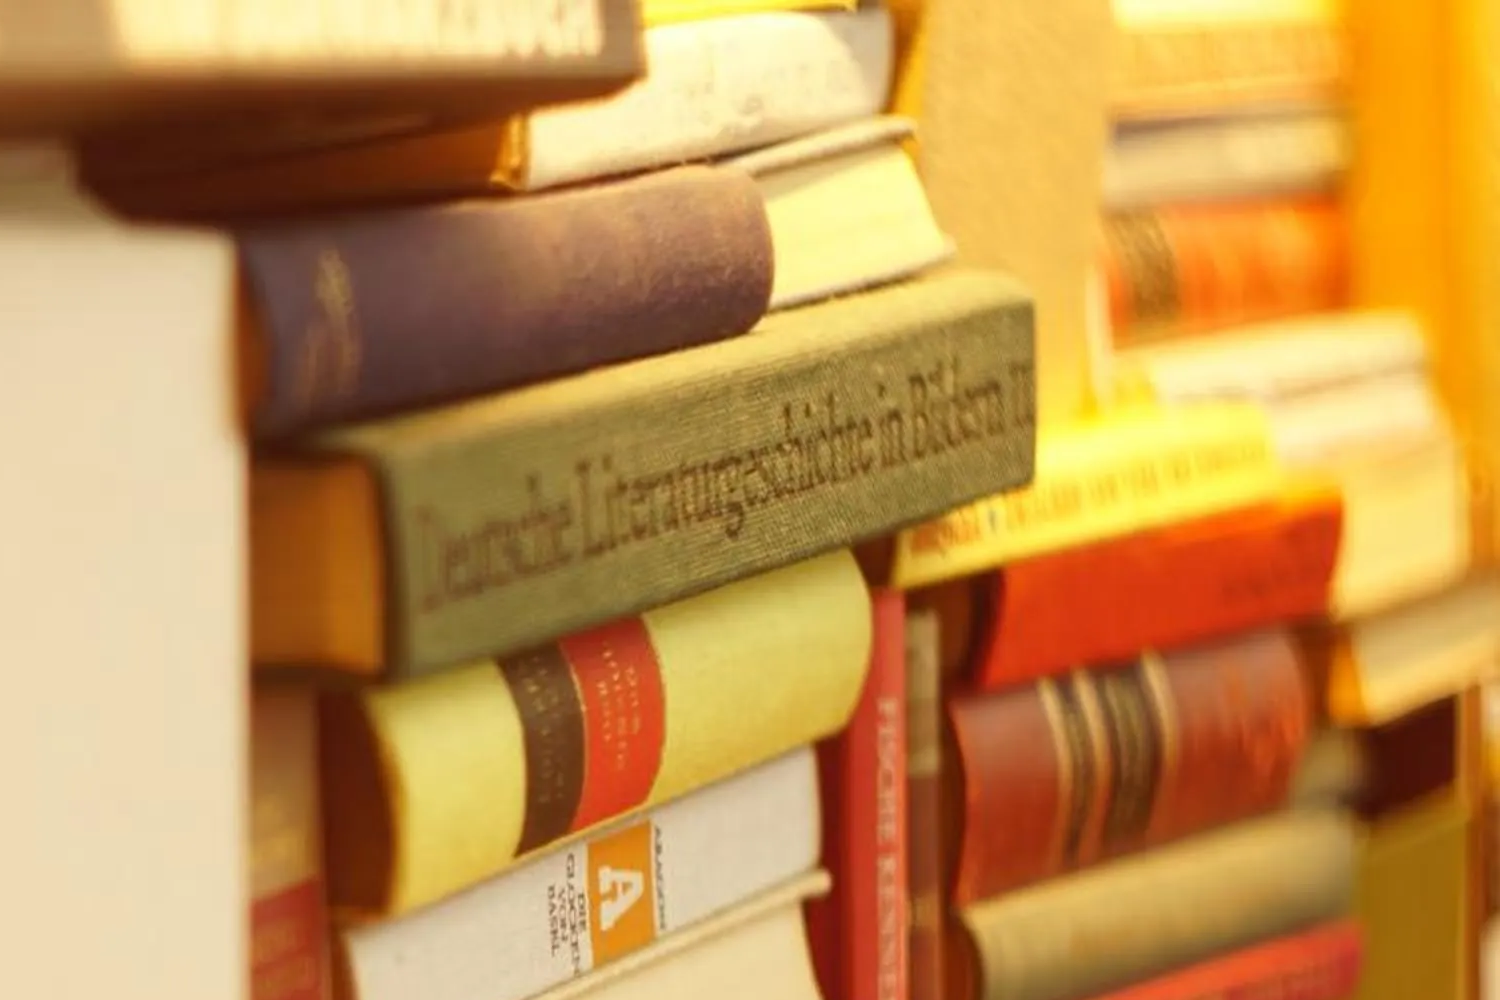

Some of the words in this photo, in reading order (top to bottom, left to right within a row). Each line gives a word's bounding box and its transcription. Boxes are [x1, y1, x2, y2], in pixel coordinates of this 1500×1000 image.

[414, 474, 573, 615] Deutsche
[574, 392, 873, 557] Literaturgeschichte
[876, 382, 907, 469] in
[877, 697, 898, 842] FISCHE
[558, 887, 569, 942] VON
[577, 892, 587, 931] DIE
[598, 865, 644, 932] A
